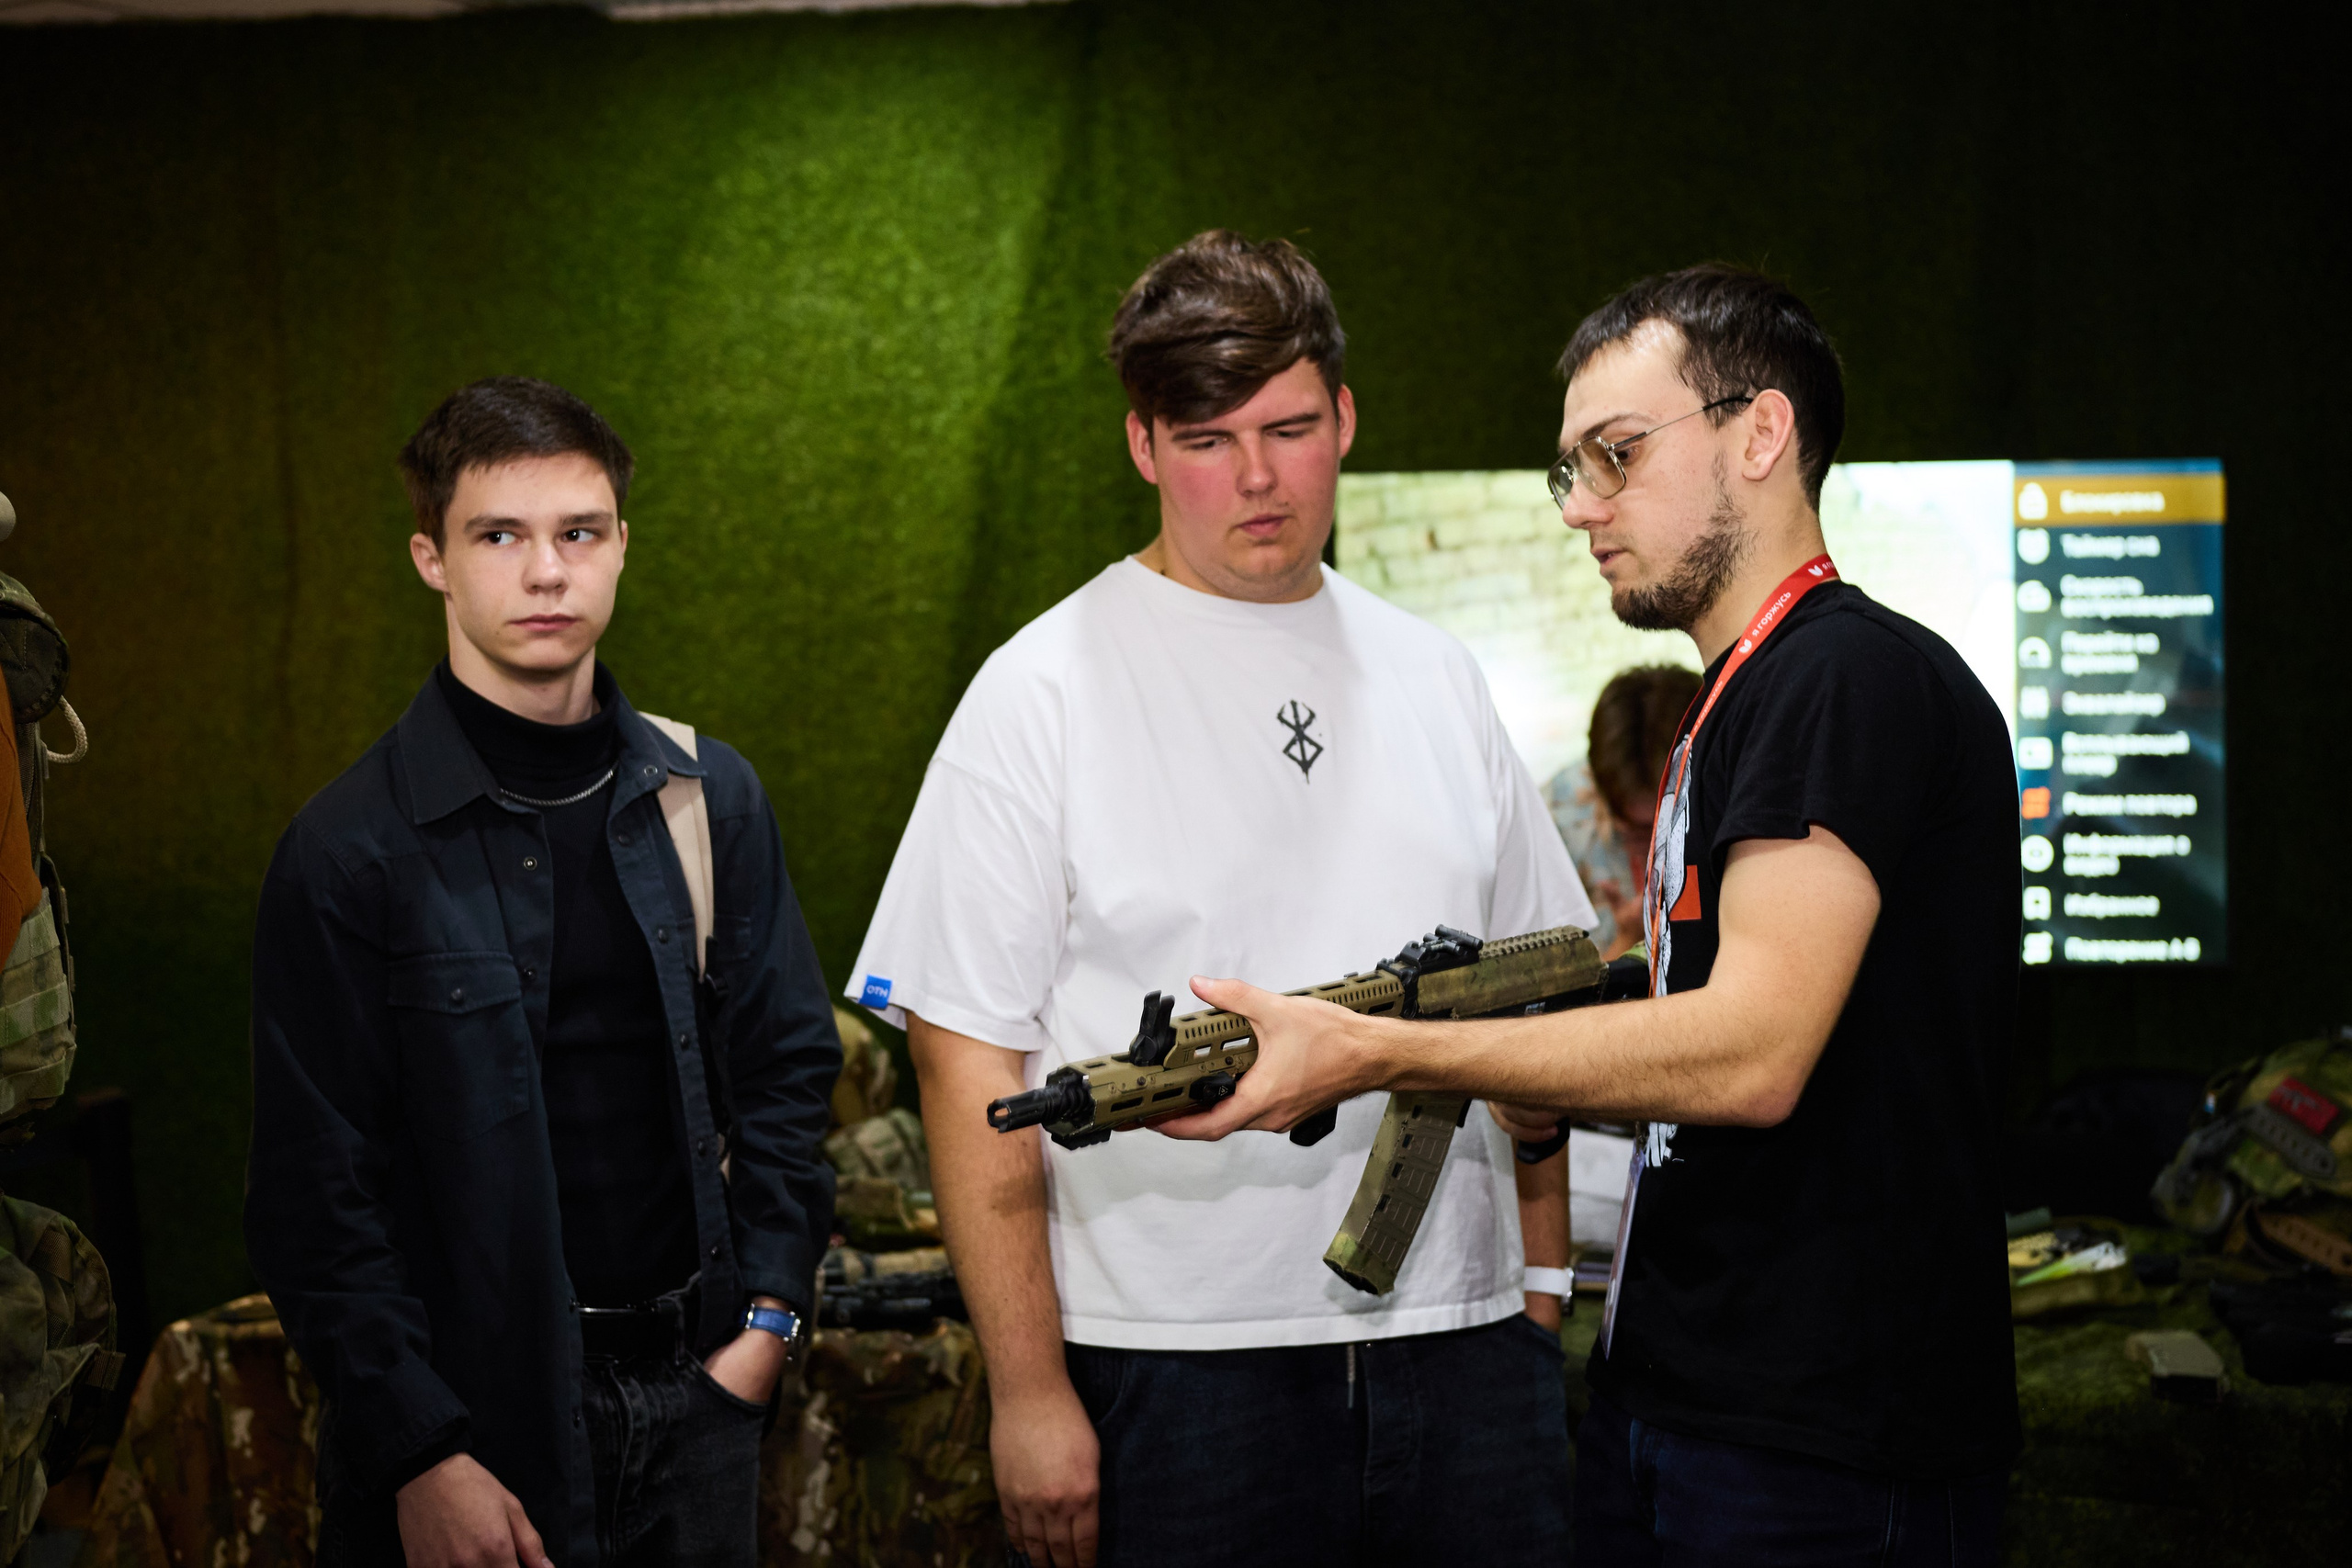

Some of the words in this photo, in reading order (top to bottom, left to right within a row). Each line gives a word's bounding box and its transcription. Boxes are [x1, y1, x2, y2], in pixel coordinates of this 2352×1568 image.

[1752, 628, 1759, 637] я
[1757, 592, 1792, 630] горжусь
[866, 985, 888, 998] OTN
